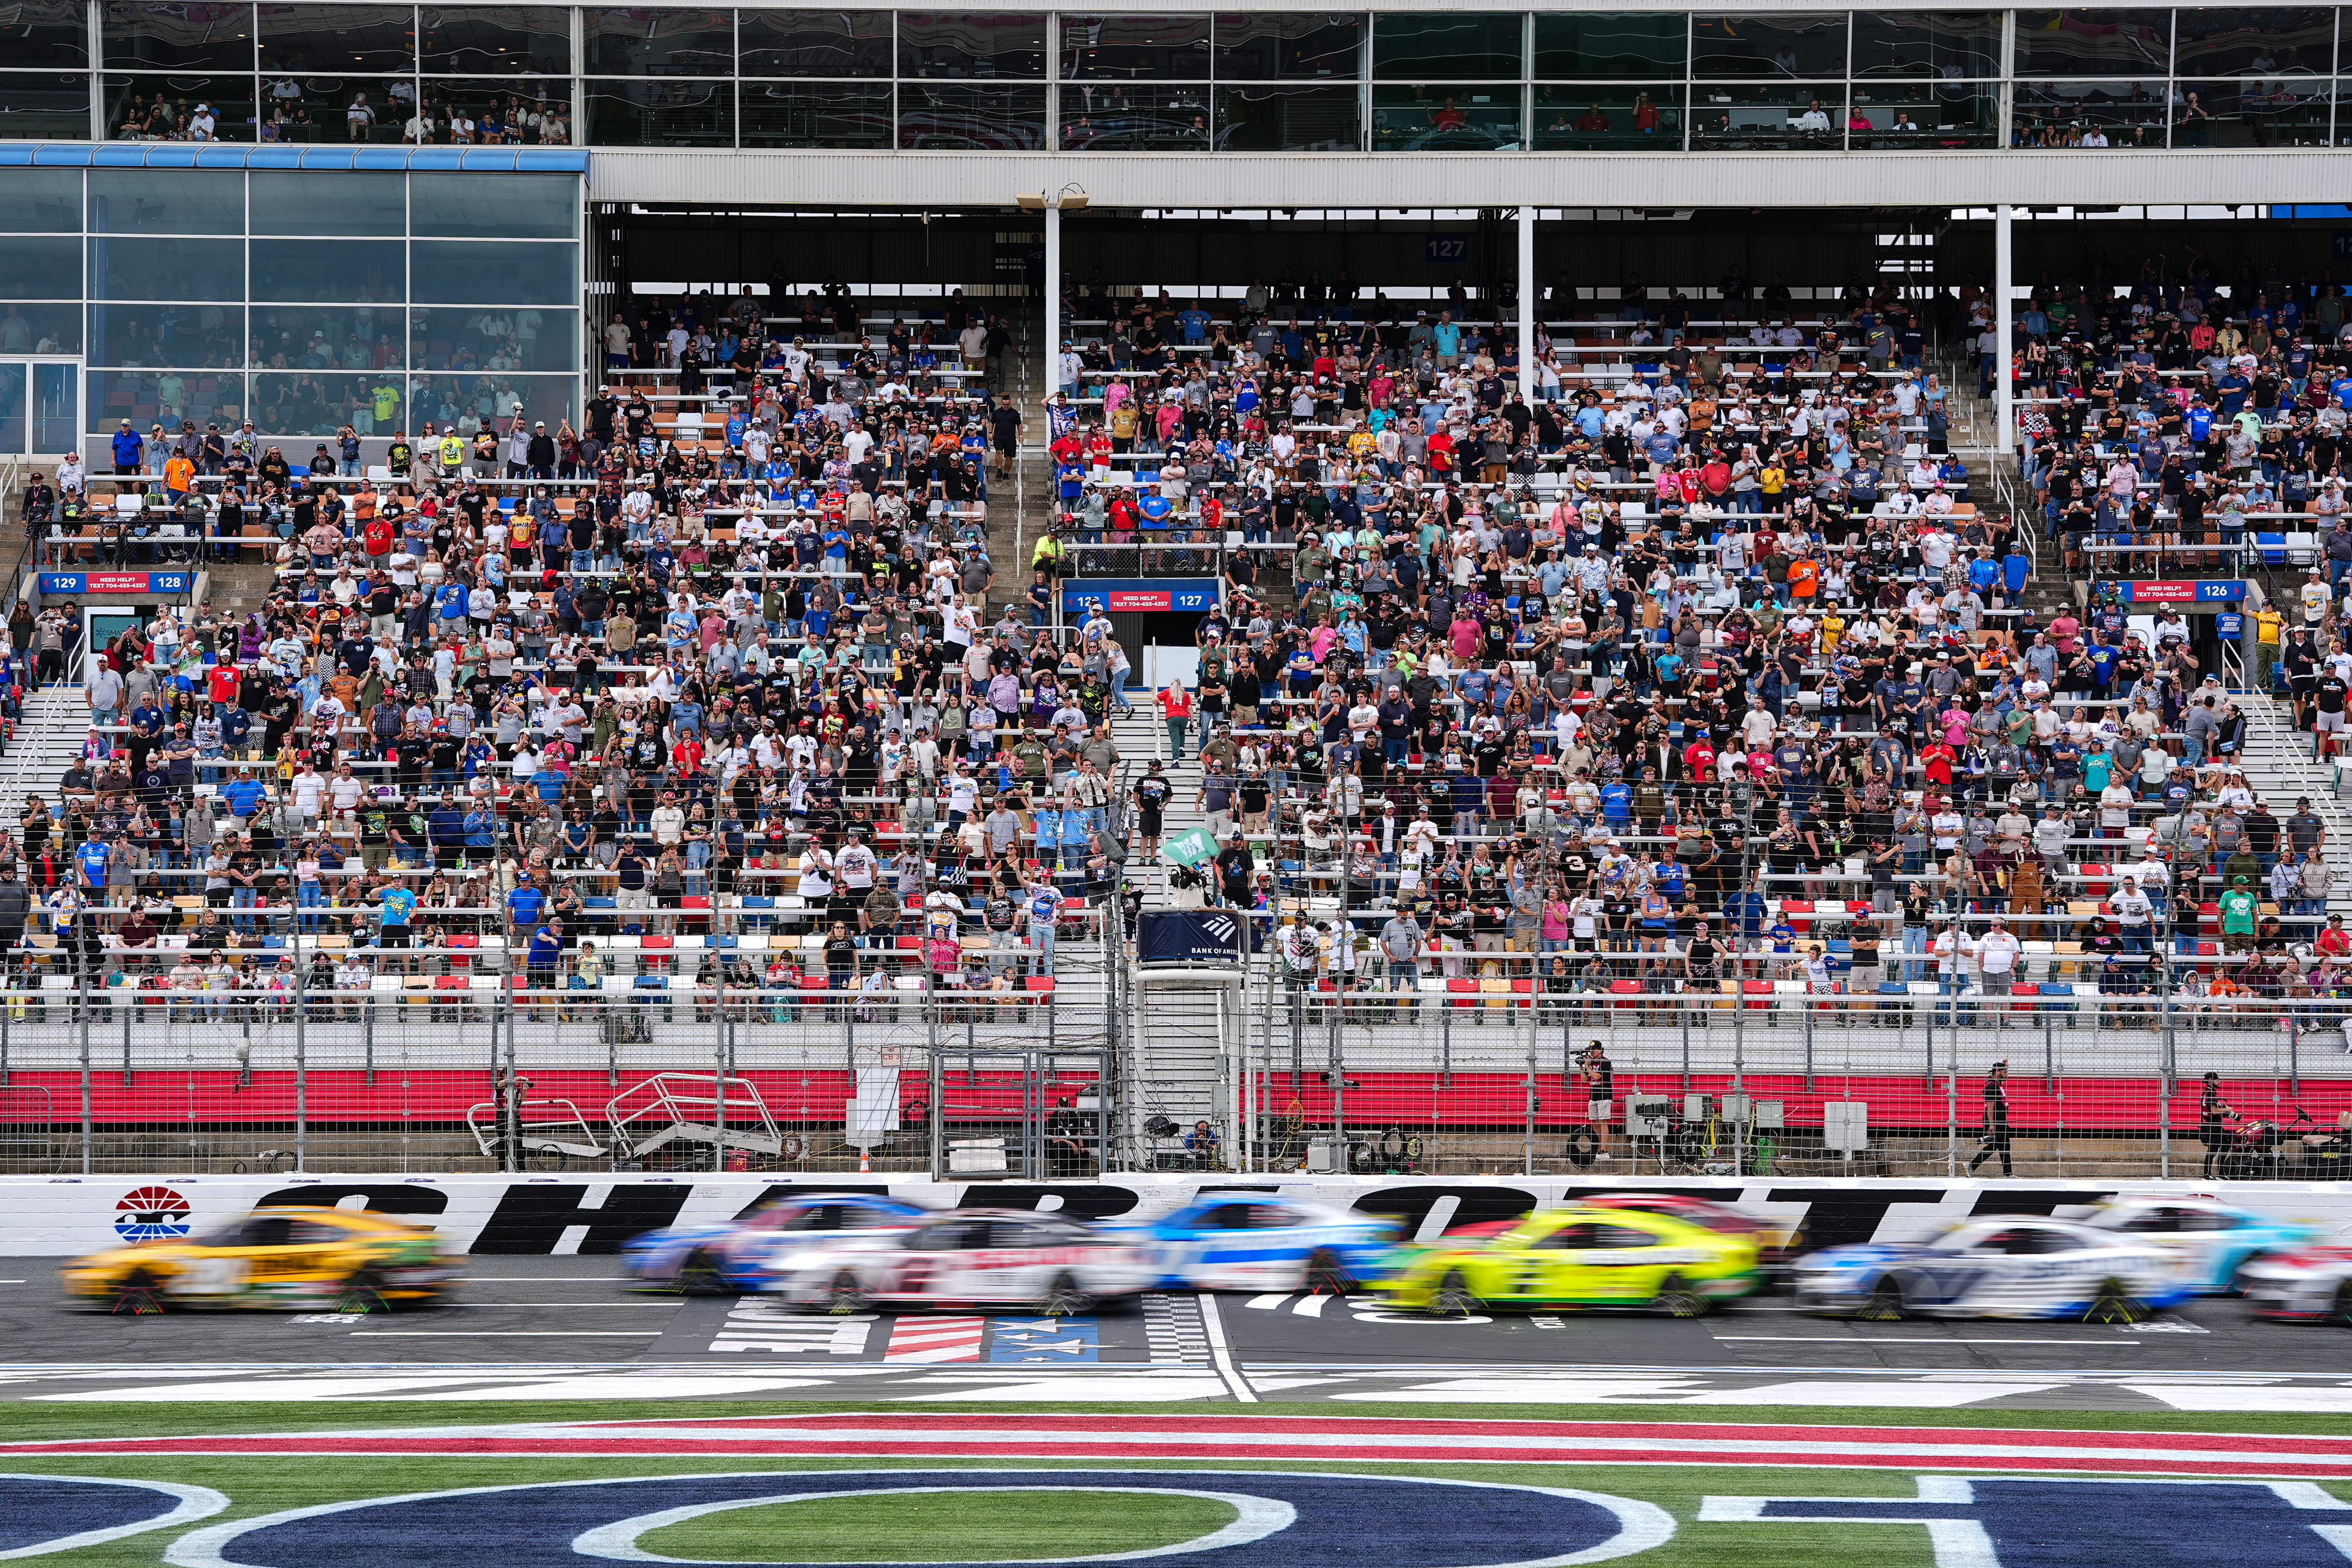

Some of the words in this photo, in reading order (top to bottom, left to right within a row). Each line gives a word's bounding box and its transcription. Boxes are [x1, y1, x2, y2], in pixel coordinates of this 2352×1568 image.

[1428, 240, 1465, 256] 127
[2106, 417, 2123, 427] 12
[1575, 531, 1584, 539] 12
[660, 557, 669, 566] 9
[53, 577, 77, 588] 129
[158, 577, 181, 588] 128
[2204, 586, 2228, 596] 126
[1180, 595, 1202, 606] 127
[673, 616, 690, 627] ELLIOTT
[841, 683, 857, 691] ELLIOTT
[2138, 686, 2159, 695] IOWA
[1565, 855, 1586, 871] 3
[905, 864, 917, 875] 11
